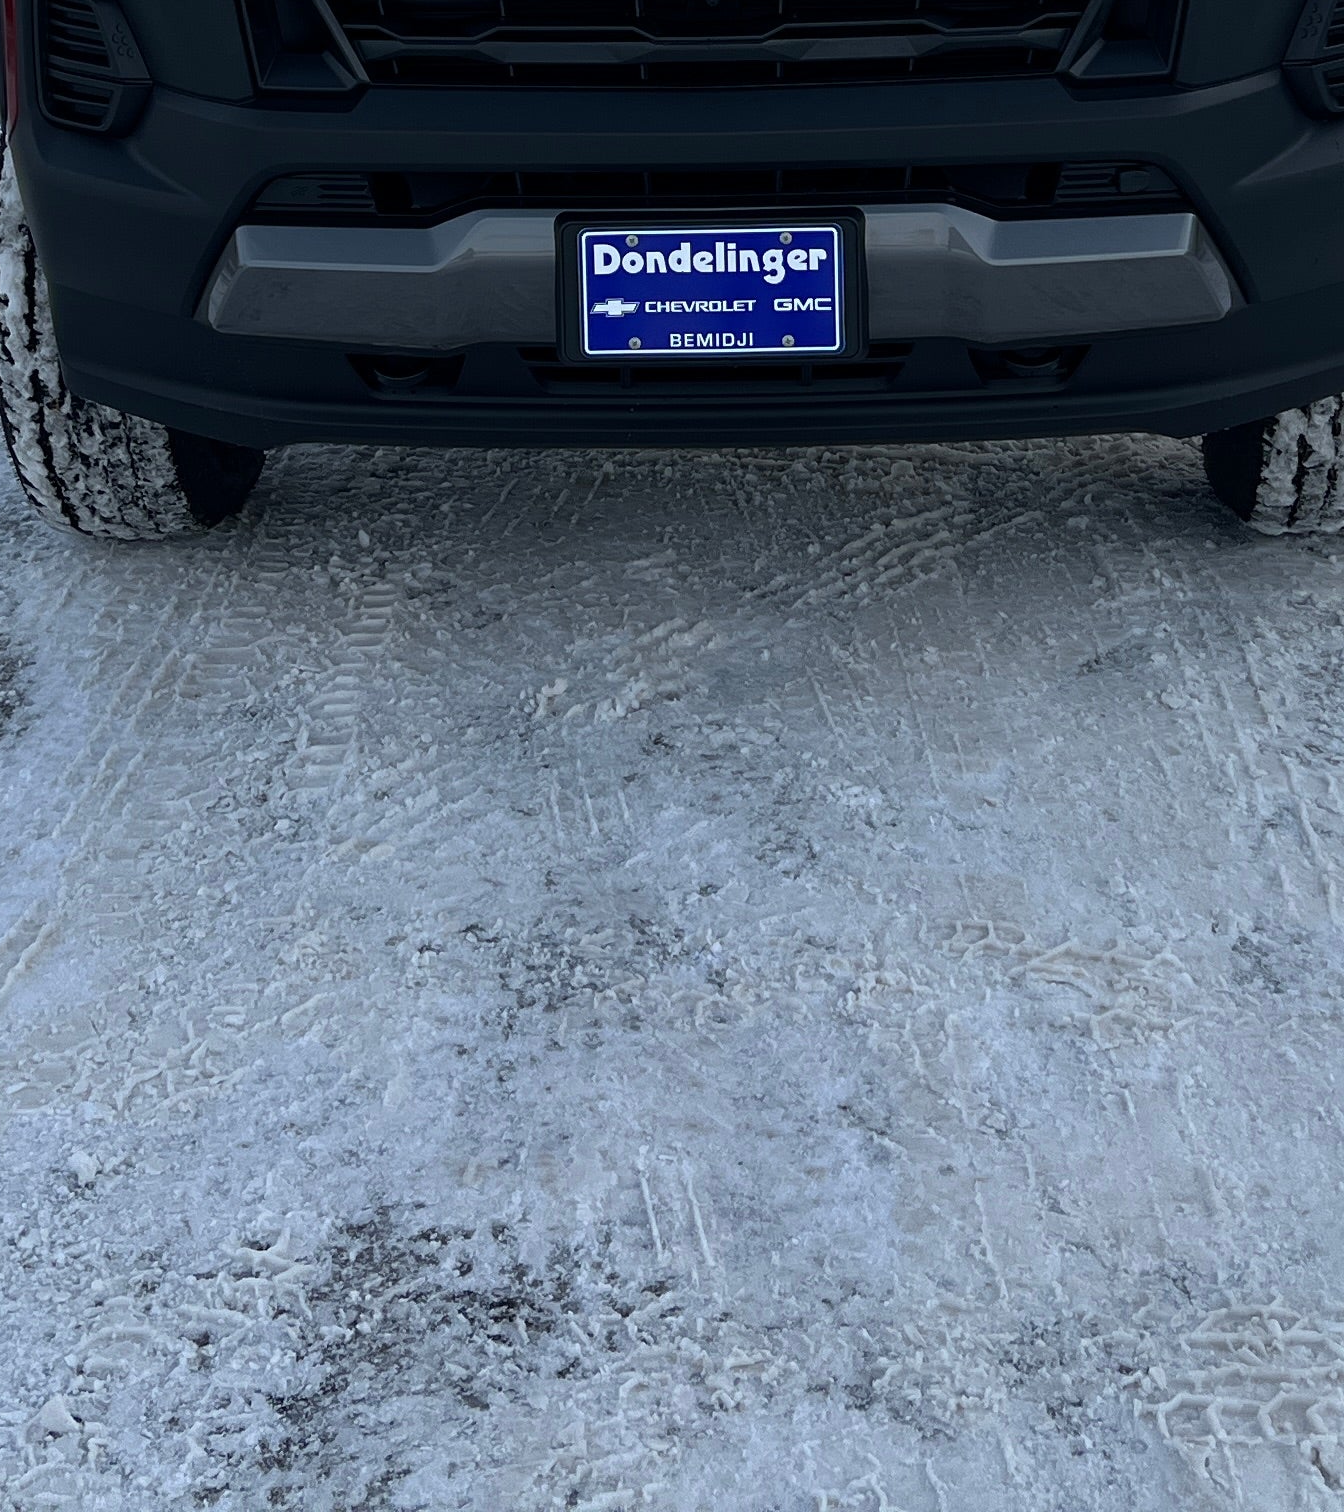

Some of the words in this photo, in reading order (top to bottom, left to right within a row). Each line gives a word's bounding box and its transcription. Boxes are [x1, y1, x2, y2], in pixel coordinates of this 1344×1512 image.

[593, 241, 828, 285] Dondelinger
[644, 299, 757, 313] CHEVROLET
[773, 297, 832, 312] GMC
[669, 332, 755, 348] BEMIDJI
